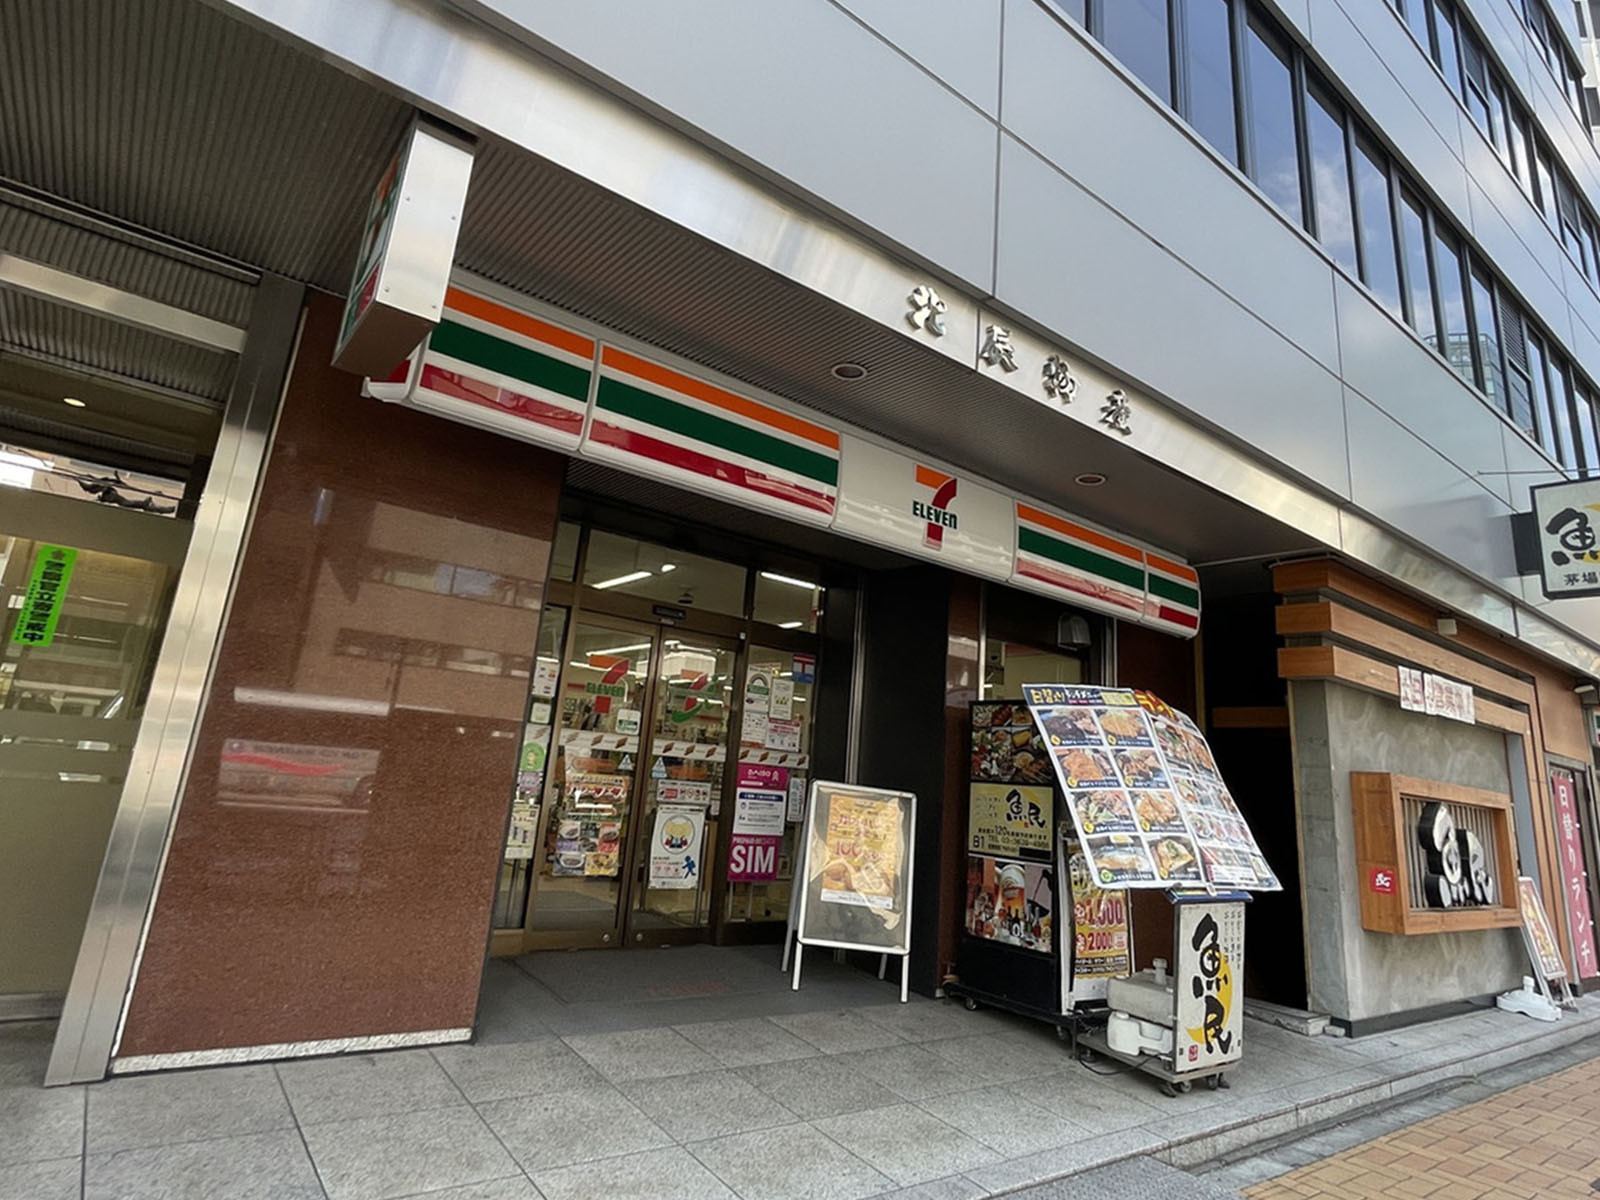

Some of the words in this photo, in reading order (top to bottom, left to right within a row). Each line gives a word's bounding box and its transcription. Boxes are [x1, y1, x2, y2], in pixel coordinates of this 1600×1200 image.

[730, 845, 775, 874] SIM
[1559, 786, 1591, 967] 日替りランチ
[1192, 912, 1232, 1055] 魚民
